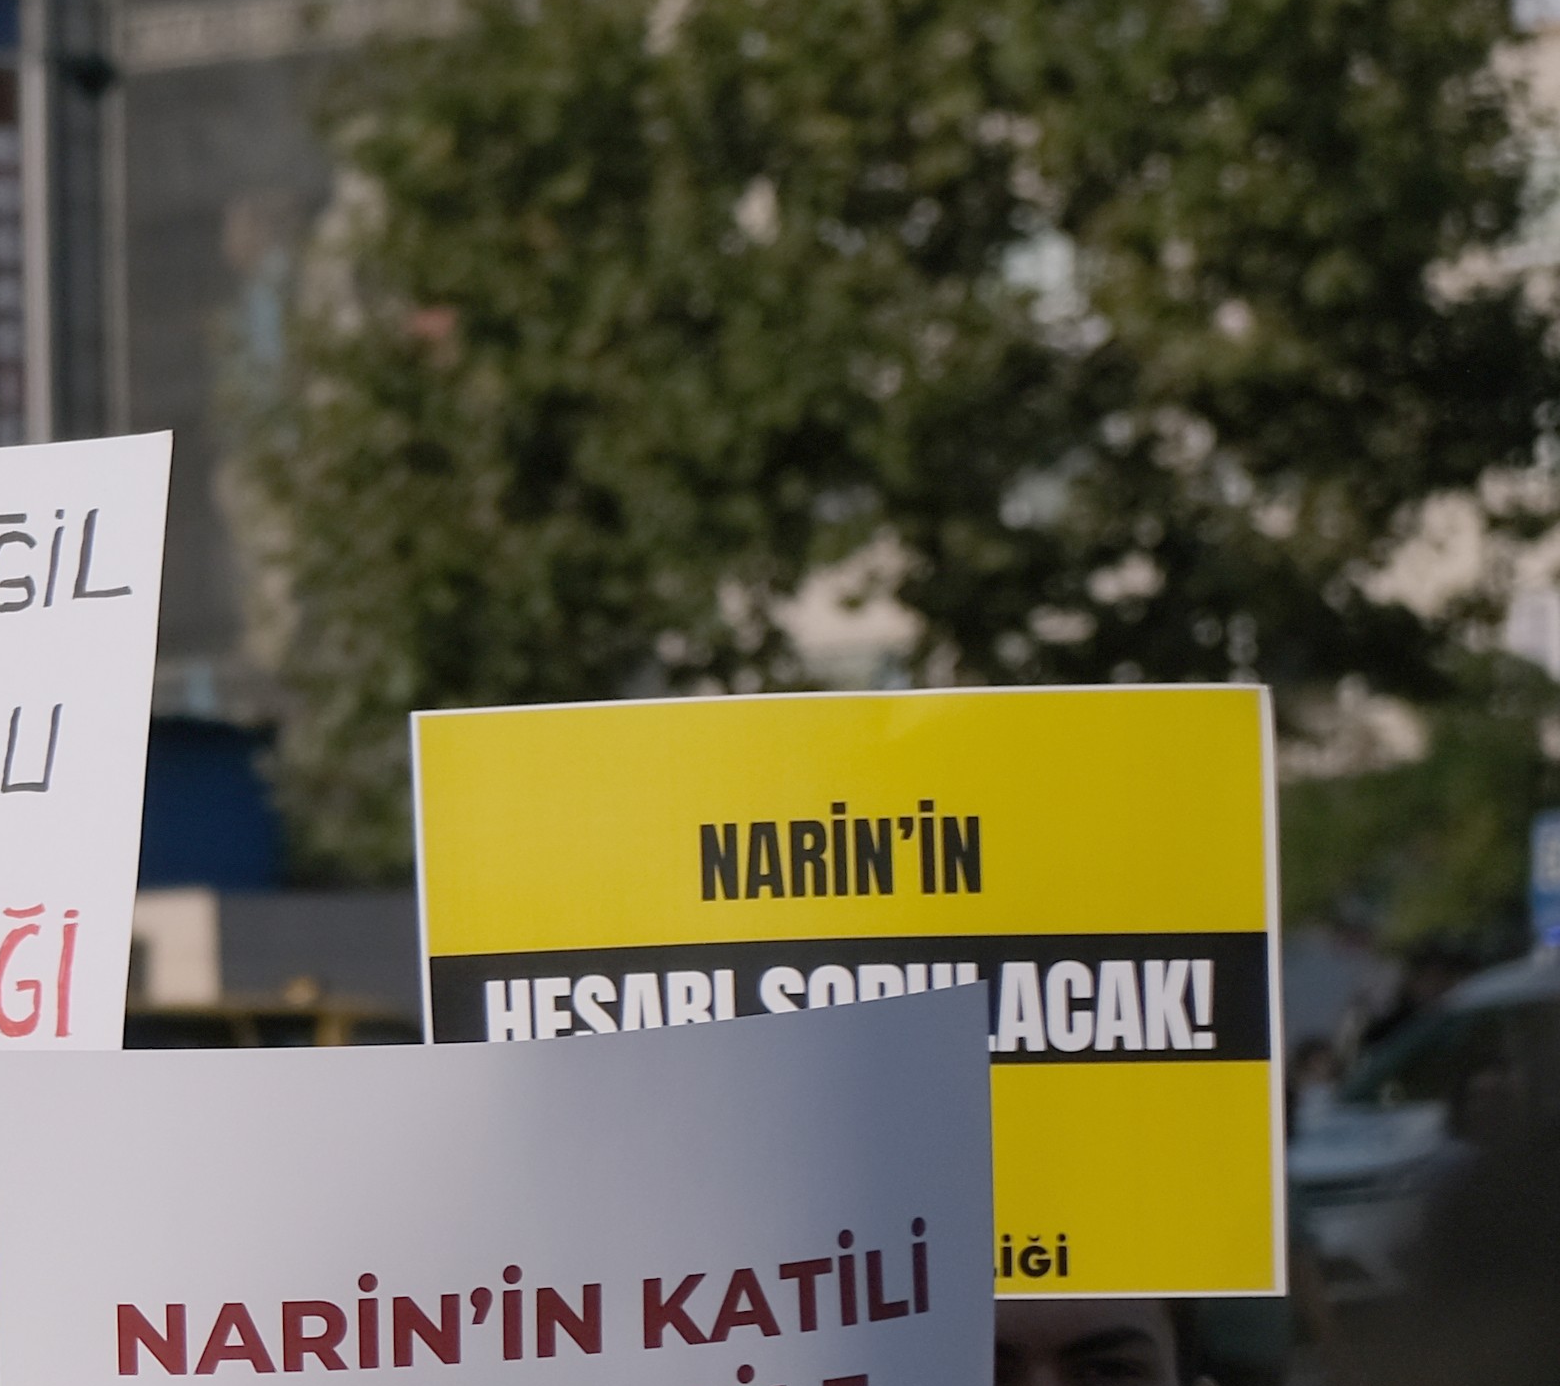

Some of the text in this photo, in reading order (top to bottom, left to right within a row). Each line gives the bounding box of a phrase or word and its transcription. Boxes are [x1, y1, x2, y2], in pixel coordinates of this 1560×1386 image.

[699, 799, 982, 902] NARİN'İN
[116, 1216, 932, 1376] NARİN'İN KATİLİ
[991, 1232, 1071, 1280] İĞİ
